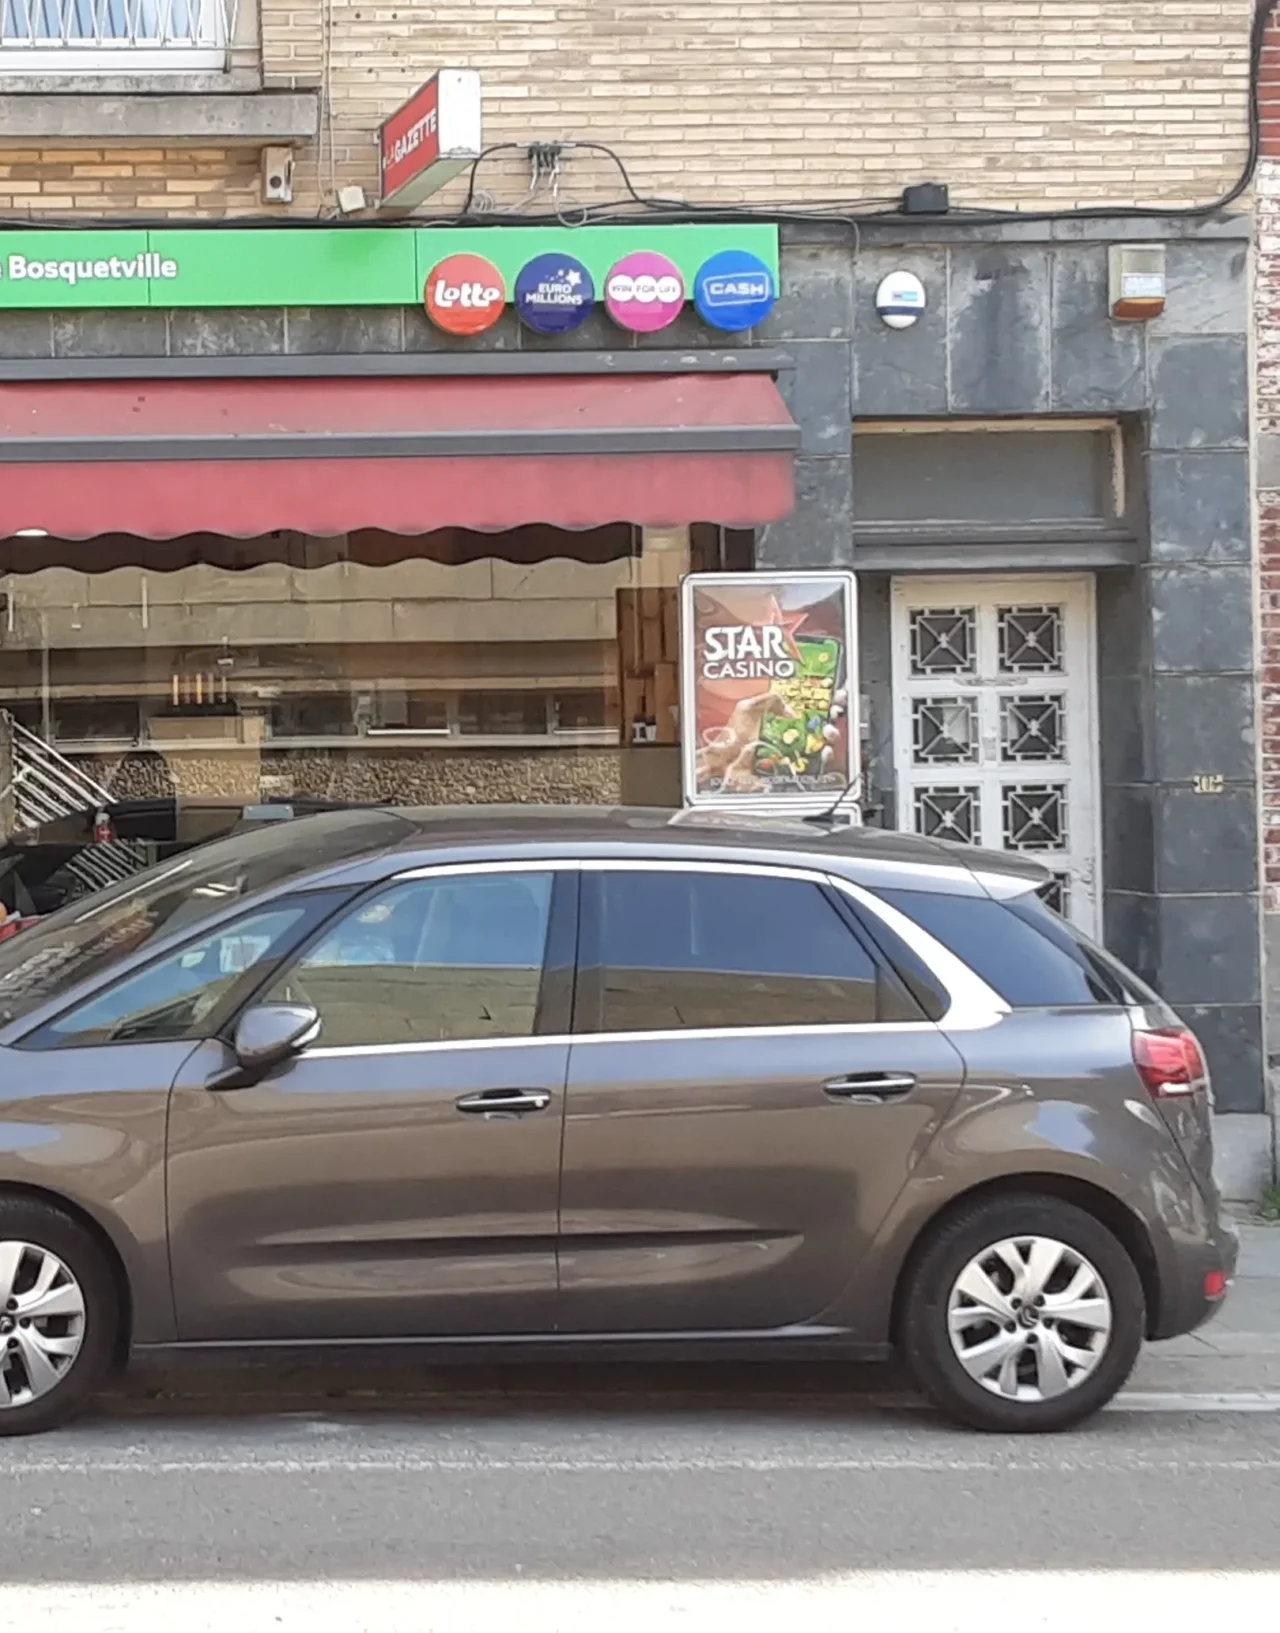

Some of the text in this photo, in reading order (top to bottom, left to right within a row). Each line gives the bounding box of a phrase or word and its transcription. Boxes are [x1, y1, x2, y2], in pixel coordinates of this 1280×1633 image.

[394, 107, 437, 163] GAZETTE
[8, 254, 177, 285] Bosquetville
[538, 283, 572, 294] EURO
[636, 284, 656, 293] FOR
[709, 282, 764, 296] CASH
[524, 292, 583, 306] MILLIONS
[703, 625, 789, 661] STAR
[703, 660, 795, 679] CASINO
